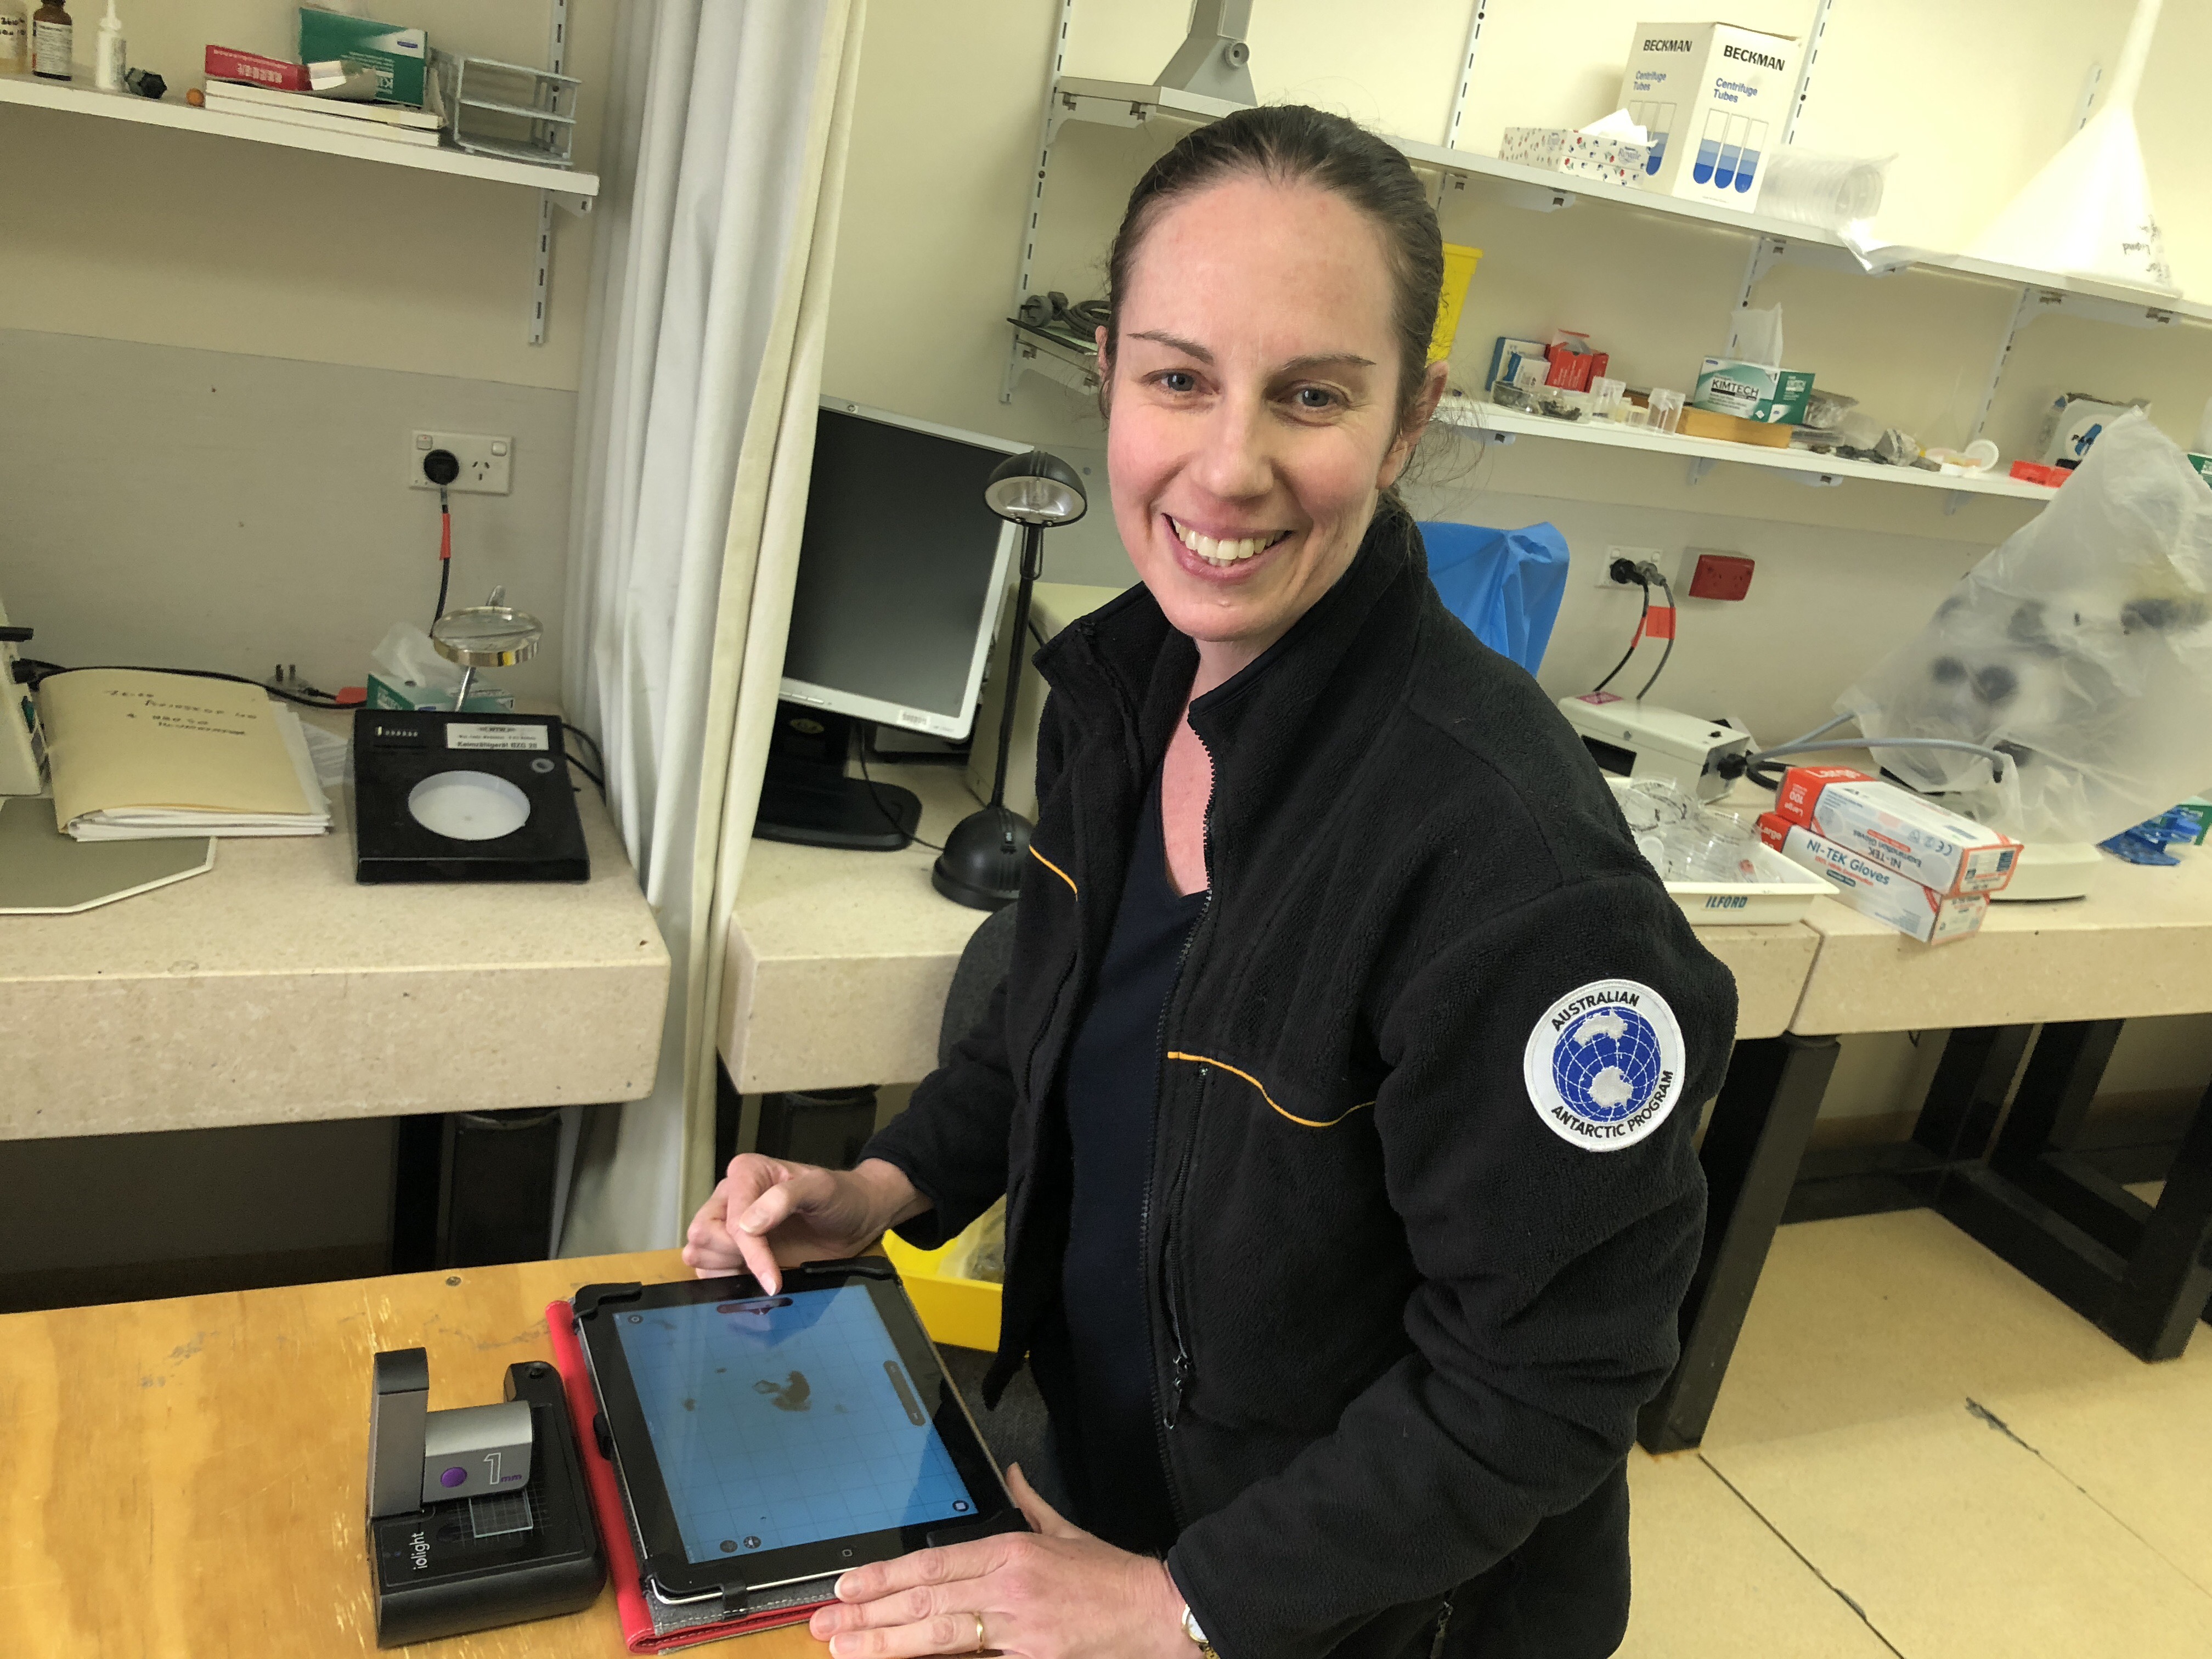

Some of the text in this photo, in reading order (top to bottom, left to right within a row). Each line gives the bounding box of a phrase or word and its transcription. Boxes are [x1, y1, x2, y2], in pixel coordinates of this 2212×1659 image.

[1643, 39, 1692, 52] BECKMAN
[1723, 44, 1785, 71] BECKMAN
[1633, 81, 1651, 91] Tubes
[1635, 70, 1667, 82] Centrifuge
[1714, 88, 1739, 103] Tubes
[1716, 77, 1758, 97] Centrifuge
[1711, 379, 1759, 397] KIMTECH
[1807, 839, 1848, 866] NI-TEK
[1849, 858, 1891, 885] Gloves
[1705, 895, 1748, 909] ILFORD
[1550, 991, 1640, 1032] AUSTRALIAN
[1550, 1070, 1674, 1139] ANTARCTIC PROGRAM
[483, 1452, 501, 1485] 1
[408, 1531, 430, 1570] iolight
